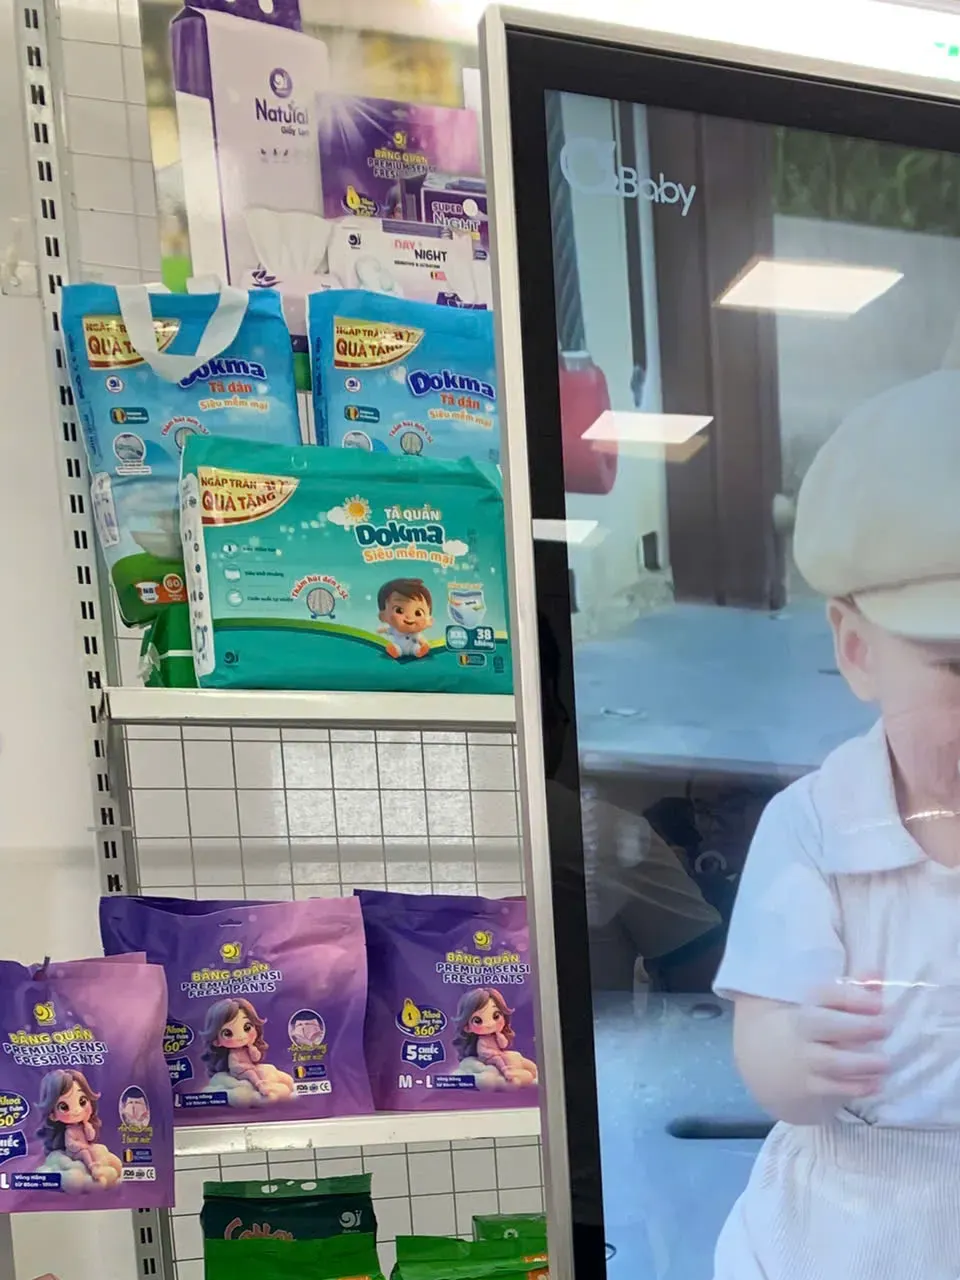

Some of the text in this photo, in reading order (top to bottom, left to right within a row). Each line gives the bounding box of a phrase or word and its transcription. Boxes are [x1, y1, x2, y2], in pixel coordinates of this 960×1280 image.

[617, 167, 696, 217] Baby
[431, 201, 463, 215] SUPER
[415, 250, 448, 262] NIGHT
[336, 338, 368, 358] QUÀ
[179, 358, 266, 388] okma
[408, 369, 496, 400] Dokma
[202, 490, 276, 512] QUÀ TẶNG
[355, 521, 445, 547] Dokma
[363, 545, 456, 568] Siêu mềm mại
[476, 628, 492, 640] 38
[447, 950, 520, 966] BĂNG QUẦN
[192, 968, 230, 982] BĂNG
[246, 970, 283, 983] SENSI
[436, 962, 531, 975] PREMIUM SENSI
[442, 973, 525, 985] FRESH PANTS
[188, 982, 277, 999] FRESH PANTS
[9, 1024, 94, 1045] BĂNG QUẦN
[2, 1040, 108, 1056] PREMIUM SENSI
[406, 1045, 418, 1061] 5
[15, 1053, 104, 1067] FRESH PANTS
[398, 1075, 412, 1089] M
[426, 1075, 434, 1089] L
